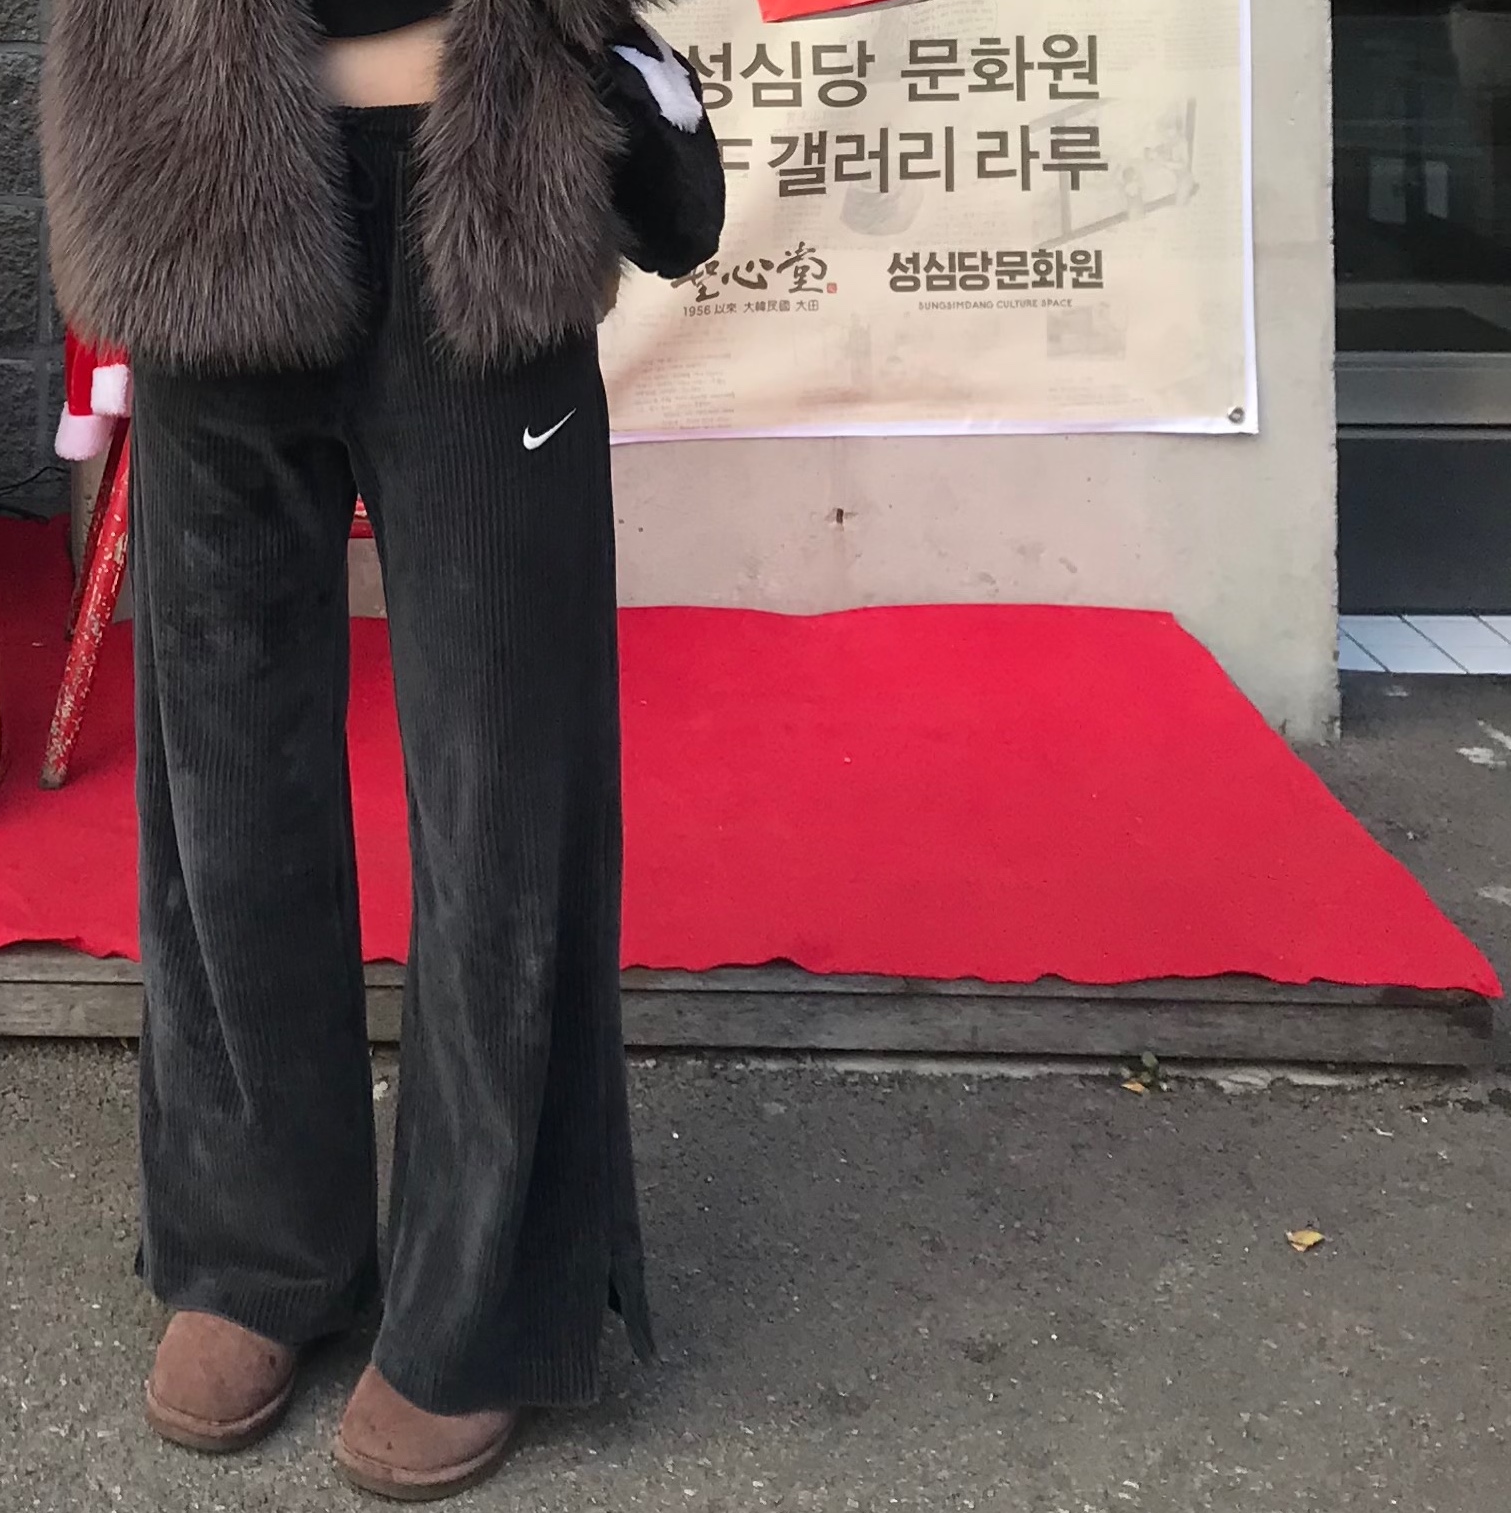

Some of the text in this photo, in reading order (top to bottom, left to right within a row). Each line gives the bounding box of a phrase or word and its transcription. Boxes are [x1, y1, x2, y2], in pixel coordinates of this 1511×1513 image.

[688, 34, 1100, 110] 성심당 문화원
[767, 126, 955, 198] 갤러리
[976, 124, 1109, 191] 라루
[886, 249, 1105, 293] 성심당문화원
[682, 305, 712, 317] 1956
[918, 297, 1073, 311] SUNGSIMDANG CULTURE SPACE
